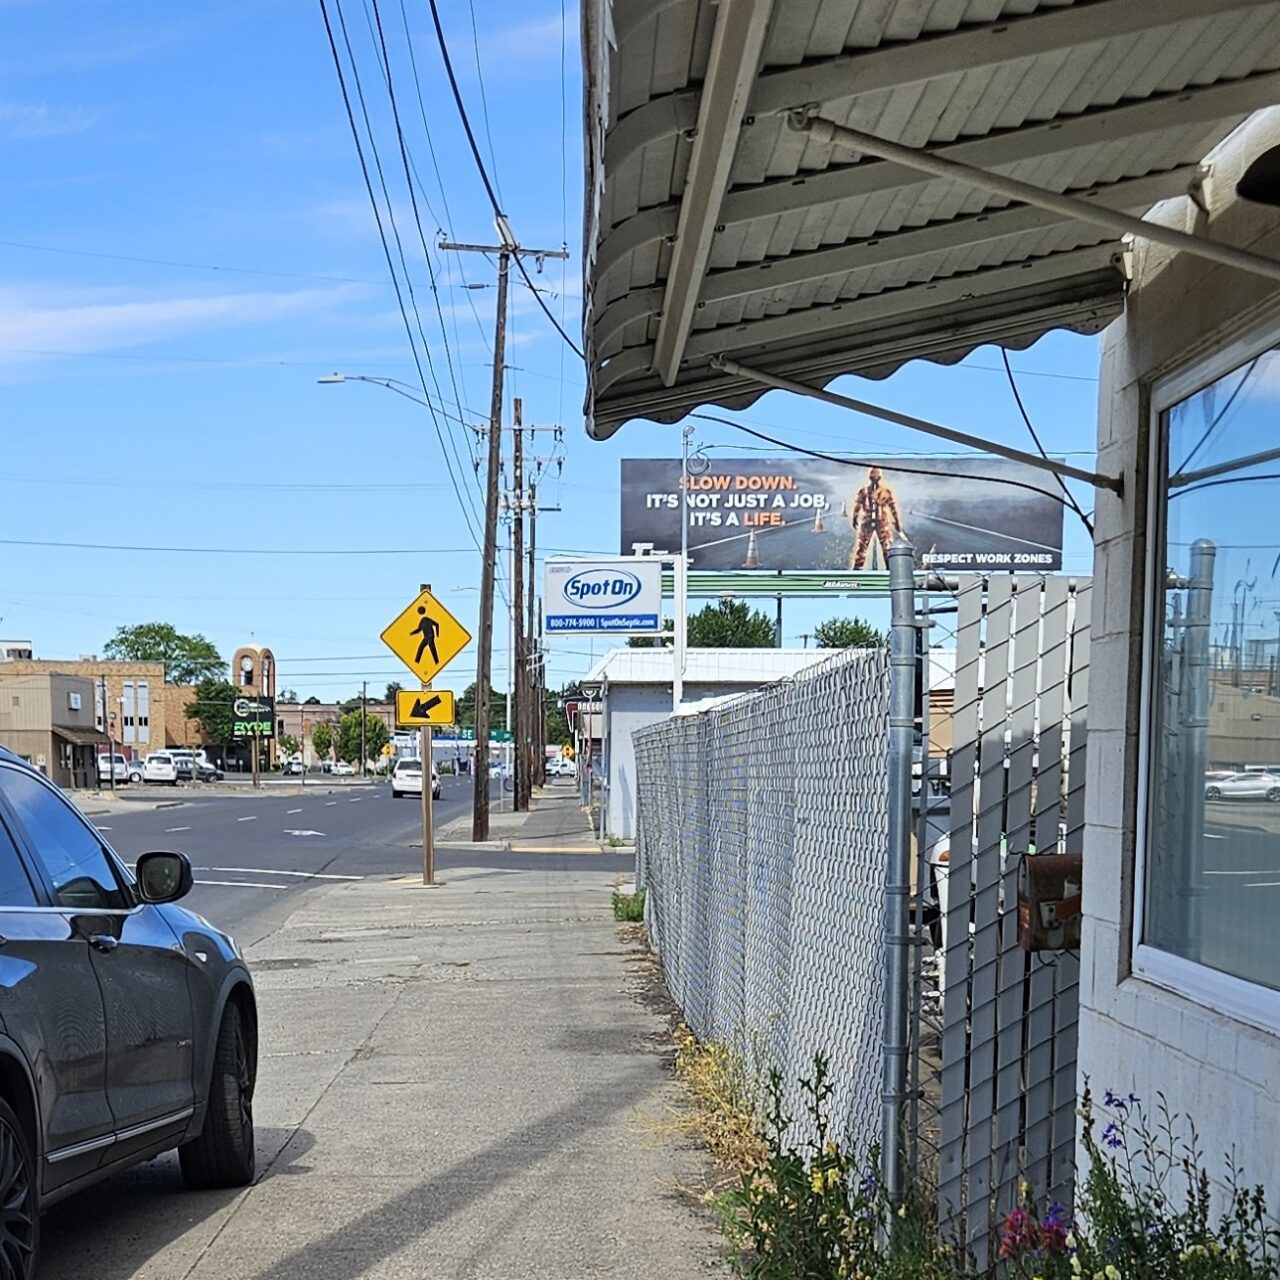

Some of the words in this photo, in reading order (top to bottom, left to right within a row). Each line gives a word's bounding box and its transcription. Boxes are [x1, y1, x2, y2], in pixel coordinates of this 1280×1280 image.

[679, 476, 731, 490] SLOW
[735, 476, 797, 490] DOWN.
[646, 494, 679, 508] IT'S
[685, 494, 720, 508] NOT
[724, 494, 768, 508] JUST
[772, 494, 786, 508] A
[789, 494, 830, 510] JOB,
[690, 512, 722, 526] IT'S
[725, 512, 739, 526] A
[743, 512, 786, 527] LIFE.
[922, 553, 972, 564] RESPECT
[974, 553, 1012, 564] WORK
[1013, 553, 1053, 564] ZONES
